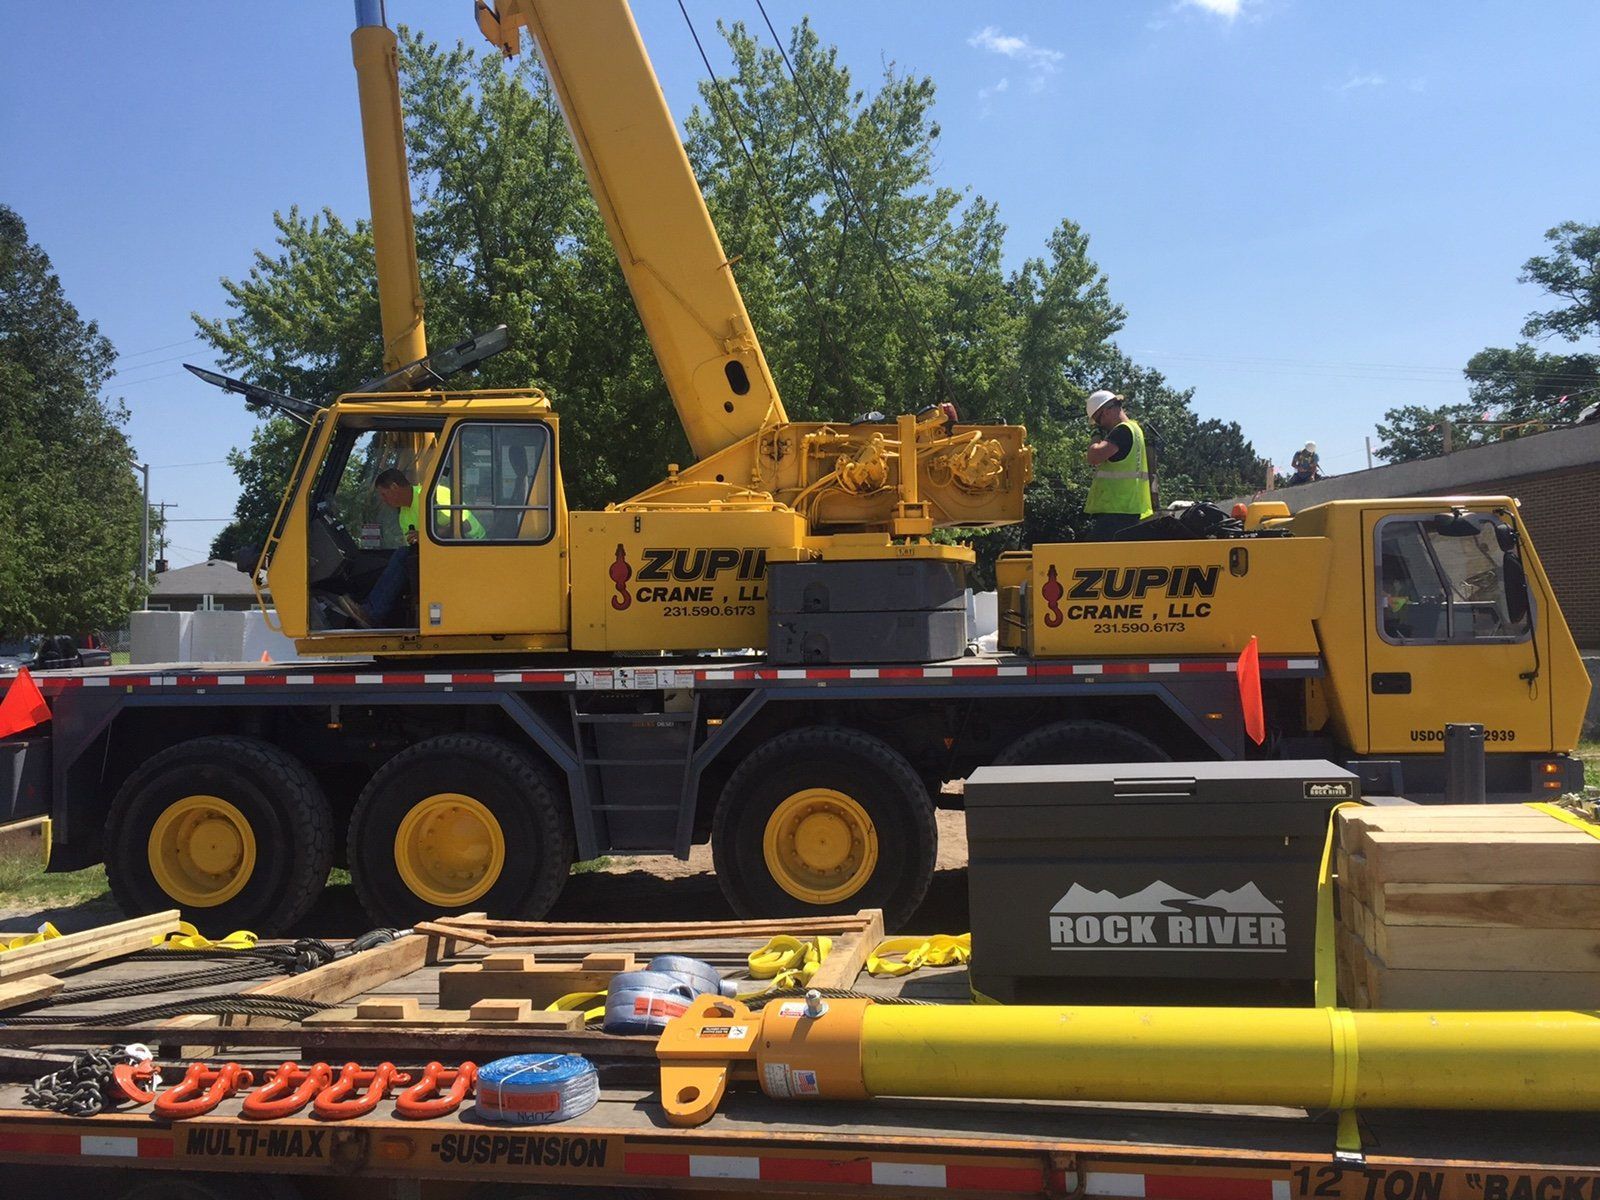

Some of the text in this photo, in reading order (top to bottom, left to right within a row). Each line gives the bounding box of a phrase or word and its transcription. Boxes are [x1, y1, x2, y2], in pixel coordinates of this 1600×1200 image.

[1067, 565, 1221, 600] ZUPIN
[636, 586, 714, 603] CRANE
[738, 586, 768, 601] LL
[663, 606, 756, 617] 231.590.6173
[1067, 604, 1143, 620] CRANE
[1168, 603, 1211, 618] LLC
[1094, 622, 1185, 633] 231.590.6173
[1050, 915, 1287, 945] ROCK RIVER
[517, 1110, 555, 1122] ZUPIN
[186, 1127, 326, 1157] MULTI-MAX
[1293, 1165, 1343, 1198] 12
[1362, 1168, 1445, 1200] TON
